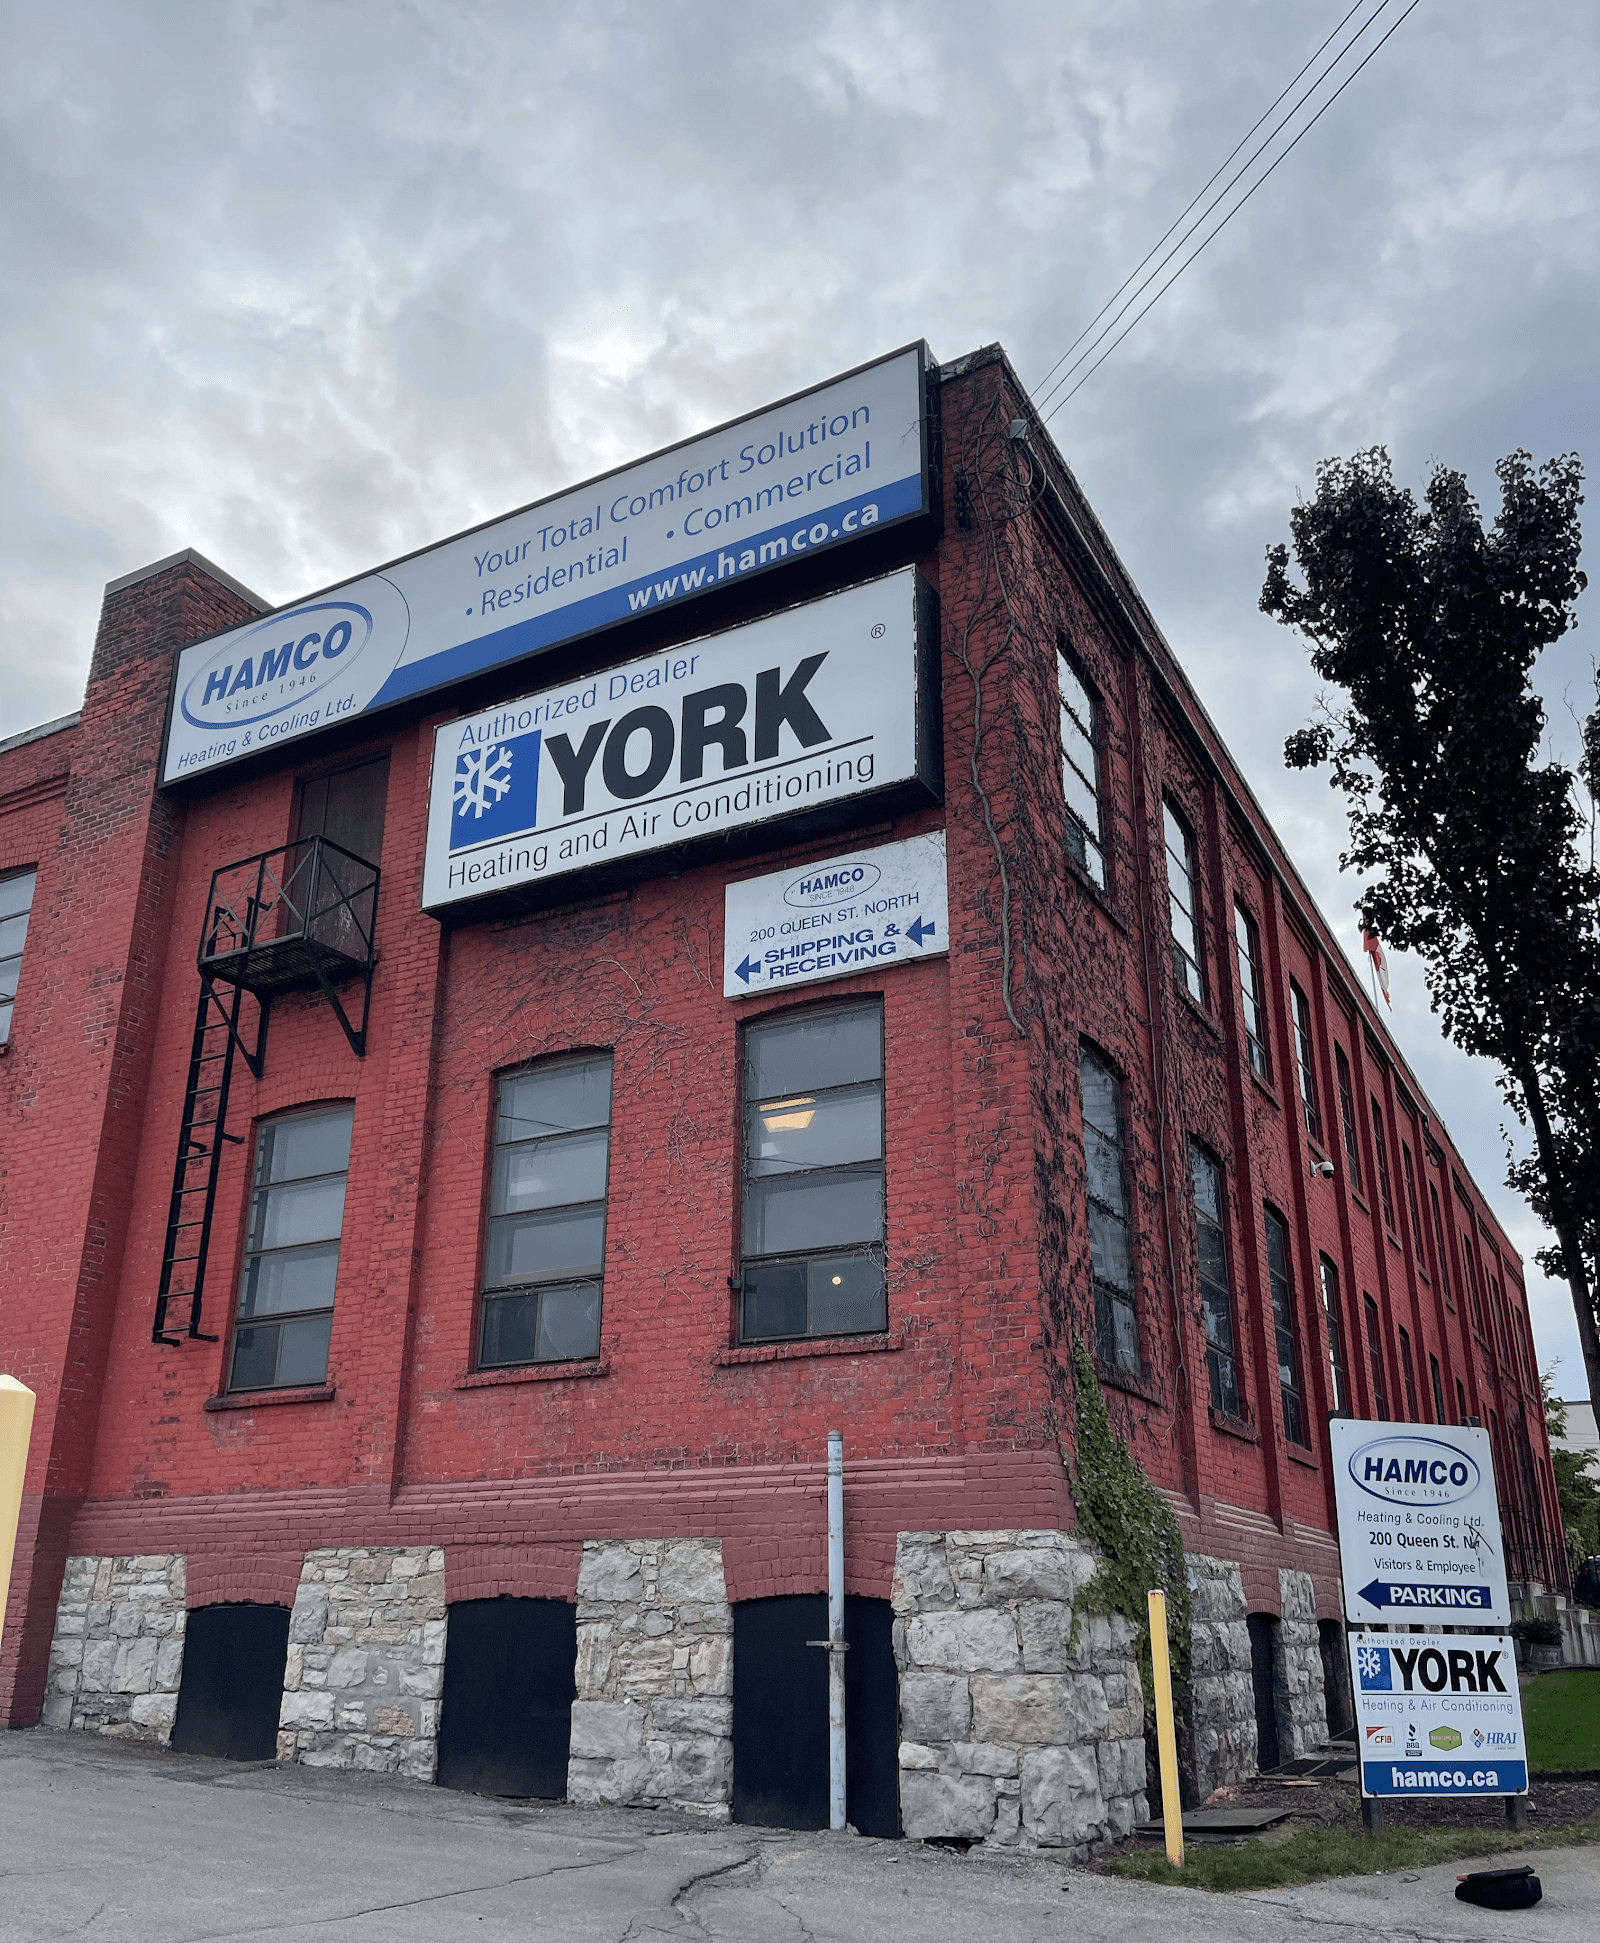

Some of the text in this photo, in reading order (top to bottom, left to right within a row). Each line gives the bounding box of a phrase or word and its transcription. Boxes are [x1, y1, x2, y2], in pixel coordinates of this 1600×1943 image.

[473, 405, 870, 577] Your Total Comfort Solution
[627, 503, 880, 612] www.hamco.ca
[201, 620, 352, 706] HAMCO
[226, 672, 316, 714] Since 1946
[459, 654, 700, 750] Authorized Dealer
[178, 694, 357, 769] Heating & Cooling Ltd.
[544, 650, 833, 817] YORK
[448, 750, 875, 889] Heating and Air Conditioning
[800, 868, 864, 895] HAMCO
[809, 885, 855, 902] SINCE 1946
[750, 892, 919, 942] 200 QUEEN ST. NORTH
[764, 923, 901, 964] SHIPPING &
[770, 941, 897, 980] RECEIVING
[1364, 1457, 1468, 1486] HAMCO
[1385, 1487, 1450, 1498] Since 1946
[1357, 1511, 1484, 1528] Heating & Cooling Ltd.
[1369, 1531, 1392, 1545] 200
[1397, 1533, 1439, 1547] Queen
[1443, 1535, 1459, 1548] St.
[1374, 1558, 1475, 1574] Visitors & Employee
[1389, 1586, 1481, 1606] PARKING
[1356, 1637, 1440, 1646] Authorized Dealer
[1391, 1648, 1508, 1692] YORK
[1363, 1699, 1513, 1714] Heating & Air Conditioning
[1486, 1733, 1517, 1744] HRAI
[1391, 1767, 1498, 1787] hamco.ca
